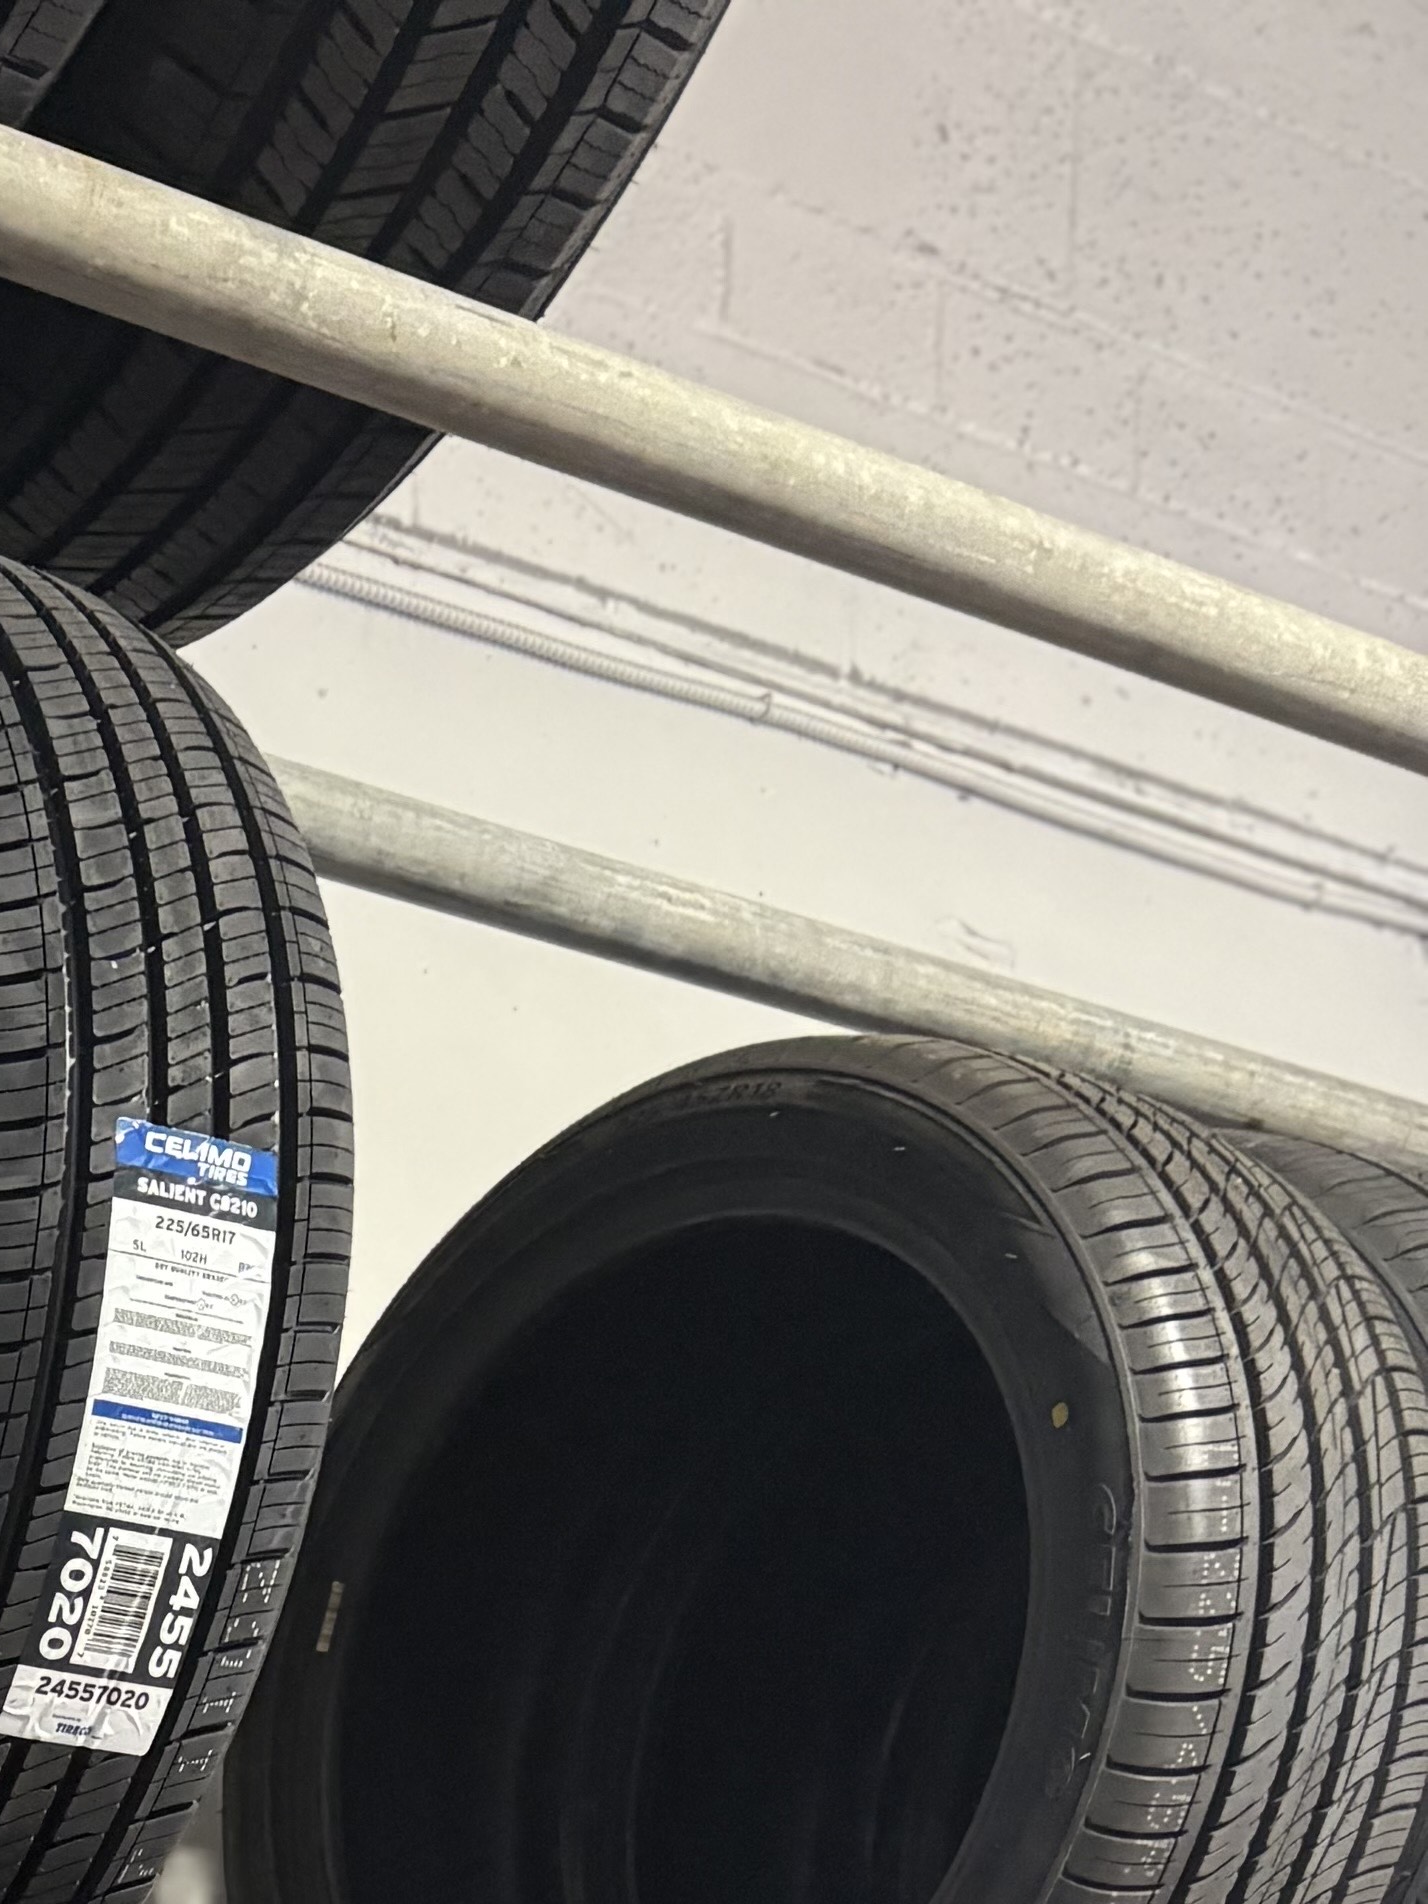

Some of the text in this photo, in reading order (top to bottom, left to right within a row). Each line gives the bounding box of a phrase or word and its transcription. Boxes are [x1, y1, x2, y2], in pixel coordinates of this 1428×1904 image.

[145, 1132, 251, 1170] CELIMO
[197, 1162, 248, 1186] TIRES
[137, 1177, 257, 1218] SALIENT CS210
[155, 1216, 235, 1245] 225/65R17
[181, 1250, 207, 1264] 102H
[39, 1527, 104, 1660] 7020
[148, 1543, 213, 1678] 2455
[34, 1675, 150, 1712] 24557020
